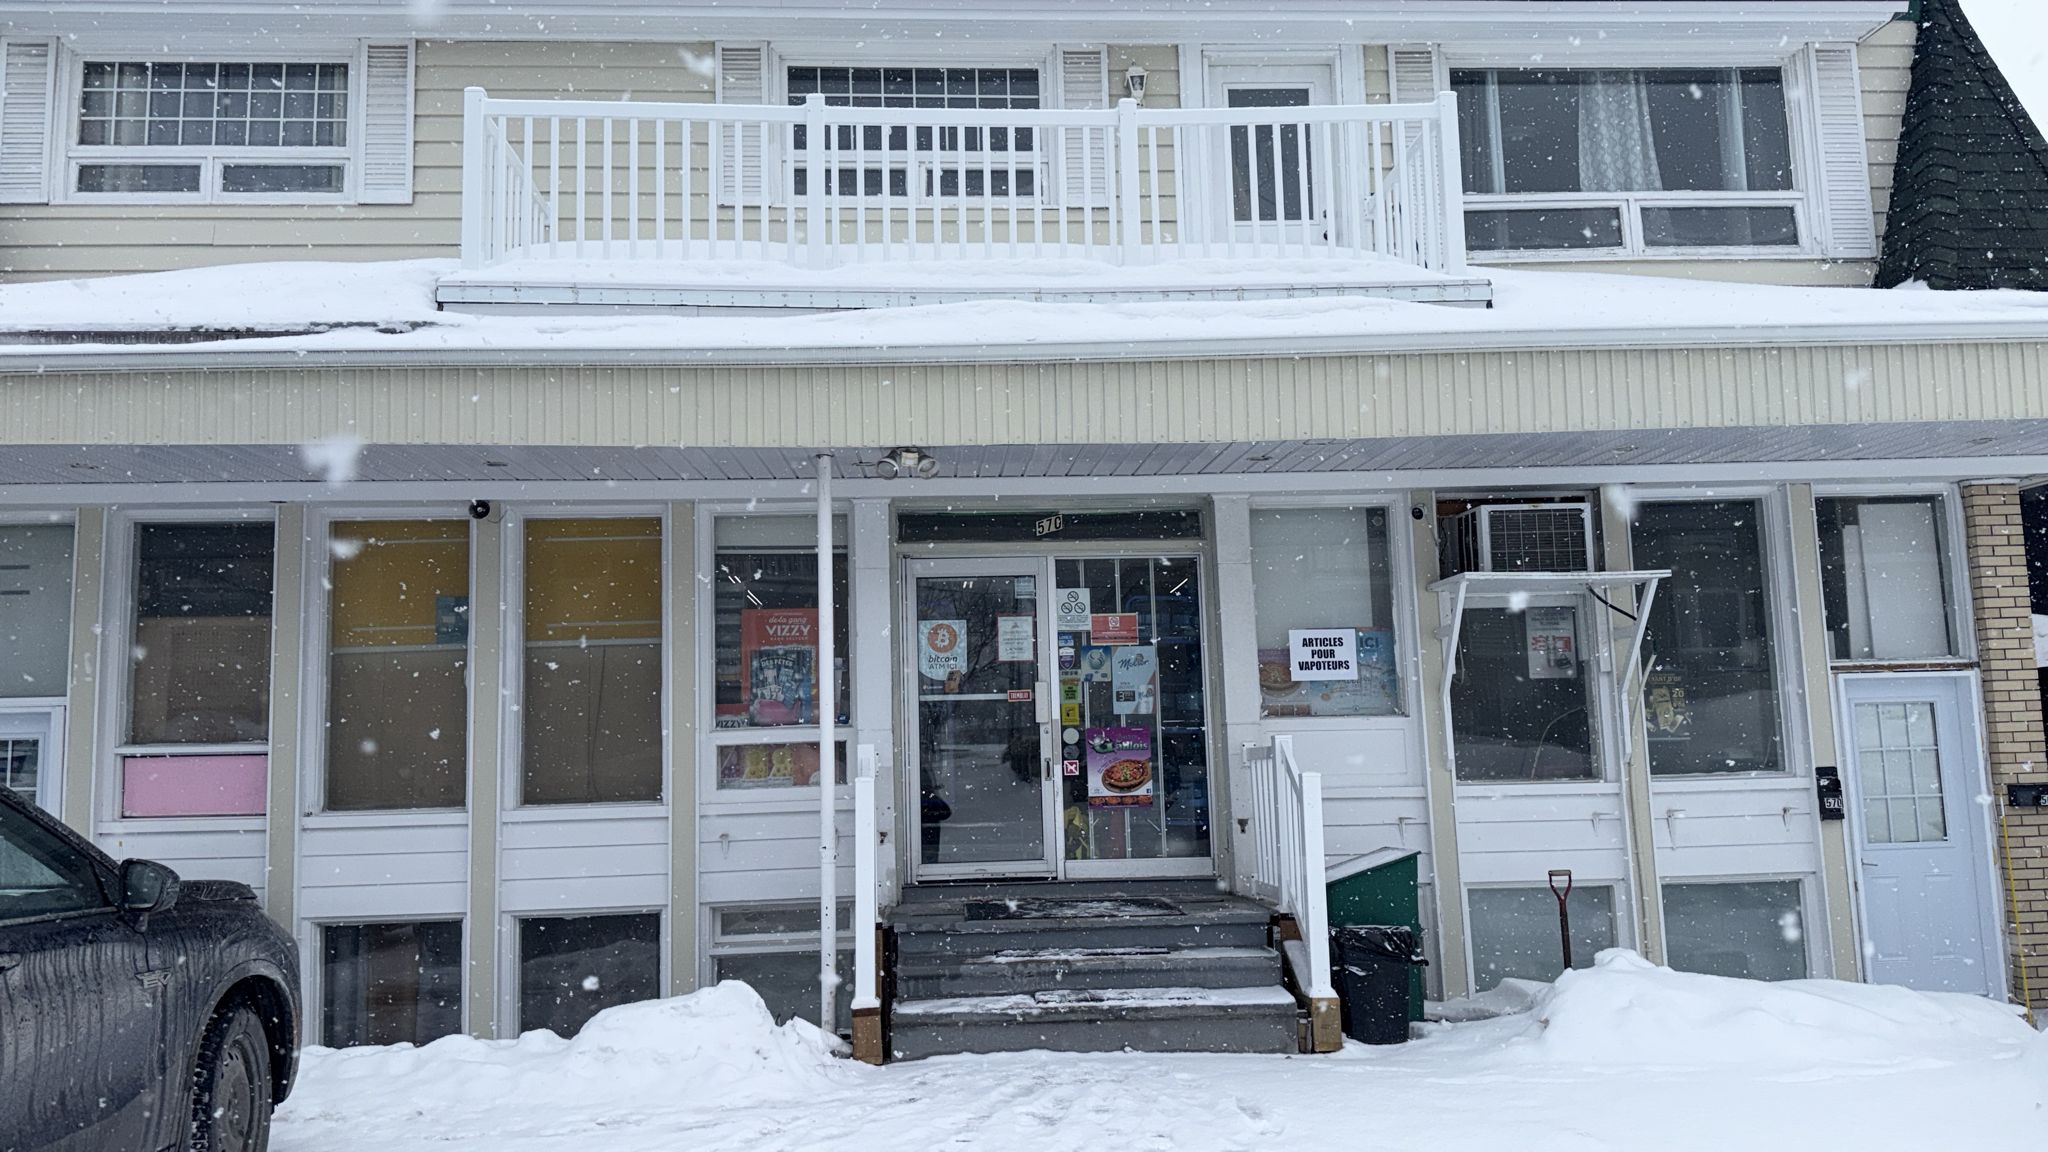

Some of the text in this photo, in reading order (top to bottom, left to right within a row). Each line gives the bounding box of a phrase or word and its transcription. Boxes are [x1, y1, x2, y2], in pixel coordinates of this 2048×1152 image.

[1037, 516, 1062, 535] 570
[765, 624, 811, 636] VIZZY
[1301, 636, 1344, 648] ARTICLES
[928, 655, 958, 663] bitcoin
[1311, 649, 1335, 659] POUR
[1298, 660, 1350, 671] VAPOTEURS
